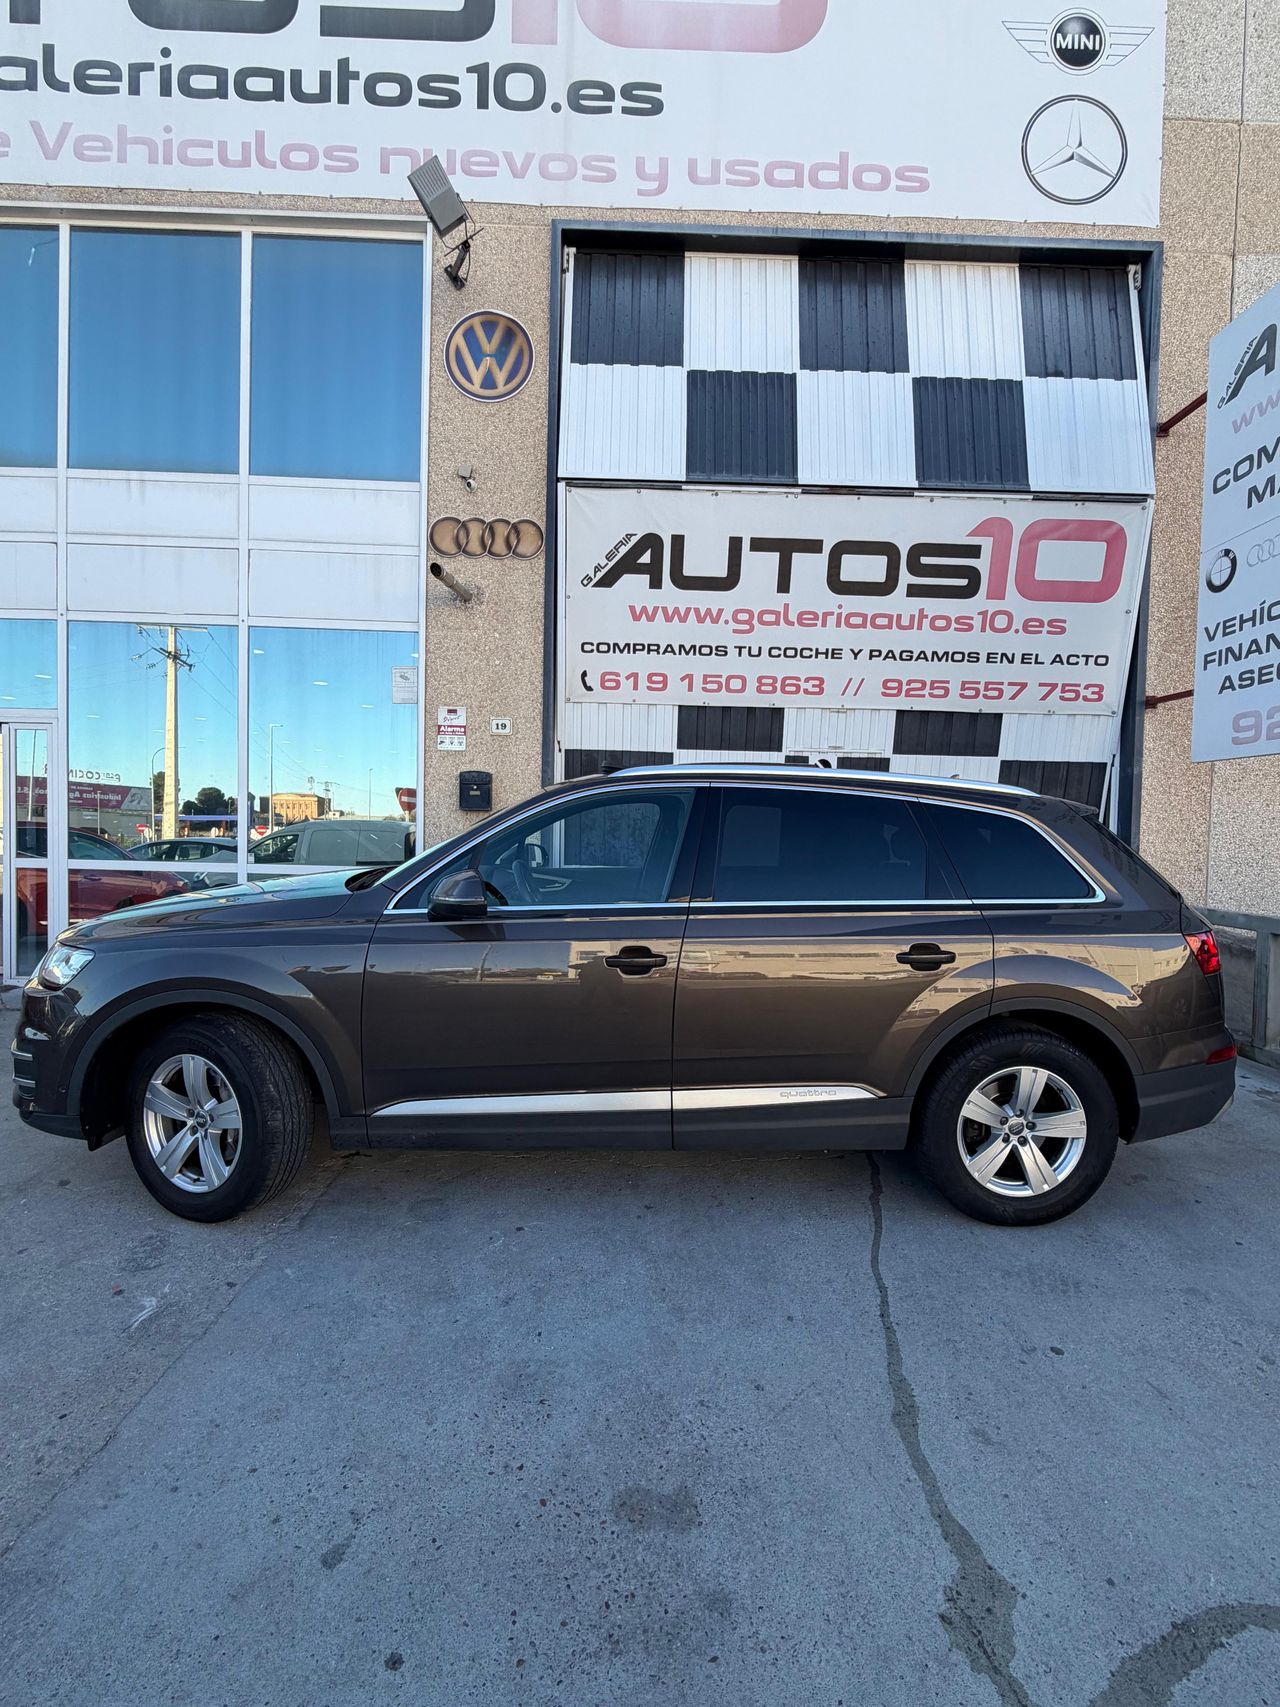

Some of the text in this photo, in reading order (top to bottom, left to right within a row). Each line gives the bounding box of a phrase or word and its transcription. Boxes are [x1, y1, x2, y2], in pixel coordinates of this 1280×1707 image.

[1056, 33, 1101, 51] MINI
[29, 120, 359, 173] Vehiculos
[380, 147, 616, 184] nuevos
[636, 156, 668, 196] y
[688, 152, 930, 194] usados
[1217, 336, 1258, 409] GALERIA
[1247, 474, 1280, 509] M
[580, 532, 638, 588] GALERIA
[591, 516, 1127, 603] AUTOS10
[628, 603, 1067, 636] www.galeriaautos10.es
[580, 641, 1111, 667] COMPRAMOS TU COCHE Y PAGAMOS EN EL ACTO
[600, 671, 669, 692] 619
[680, 674, 747, 694] 150
[756, 675, 825, 696] 863
[881, 679, 950, 699] 925
[959, 681, 1028, 701] 557
[1038, 682, 1105, 702] 753
[1218, 663, 1280, 695] ASE
[495, 722, 507, 730] 19
[779, 1089, 837, 1099] quattro
